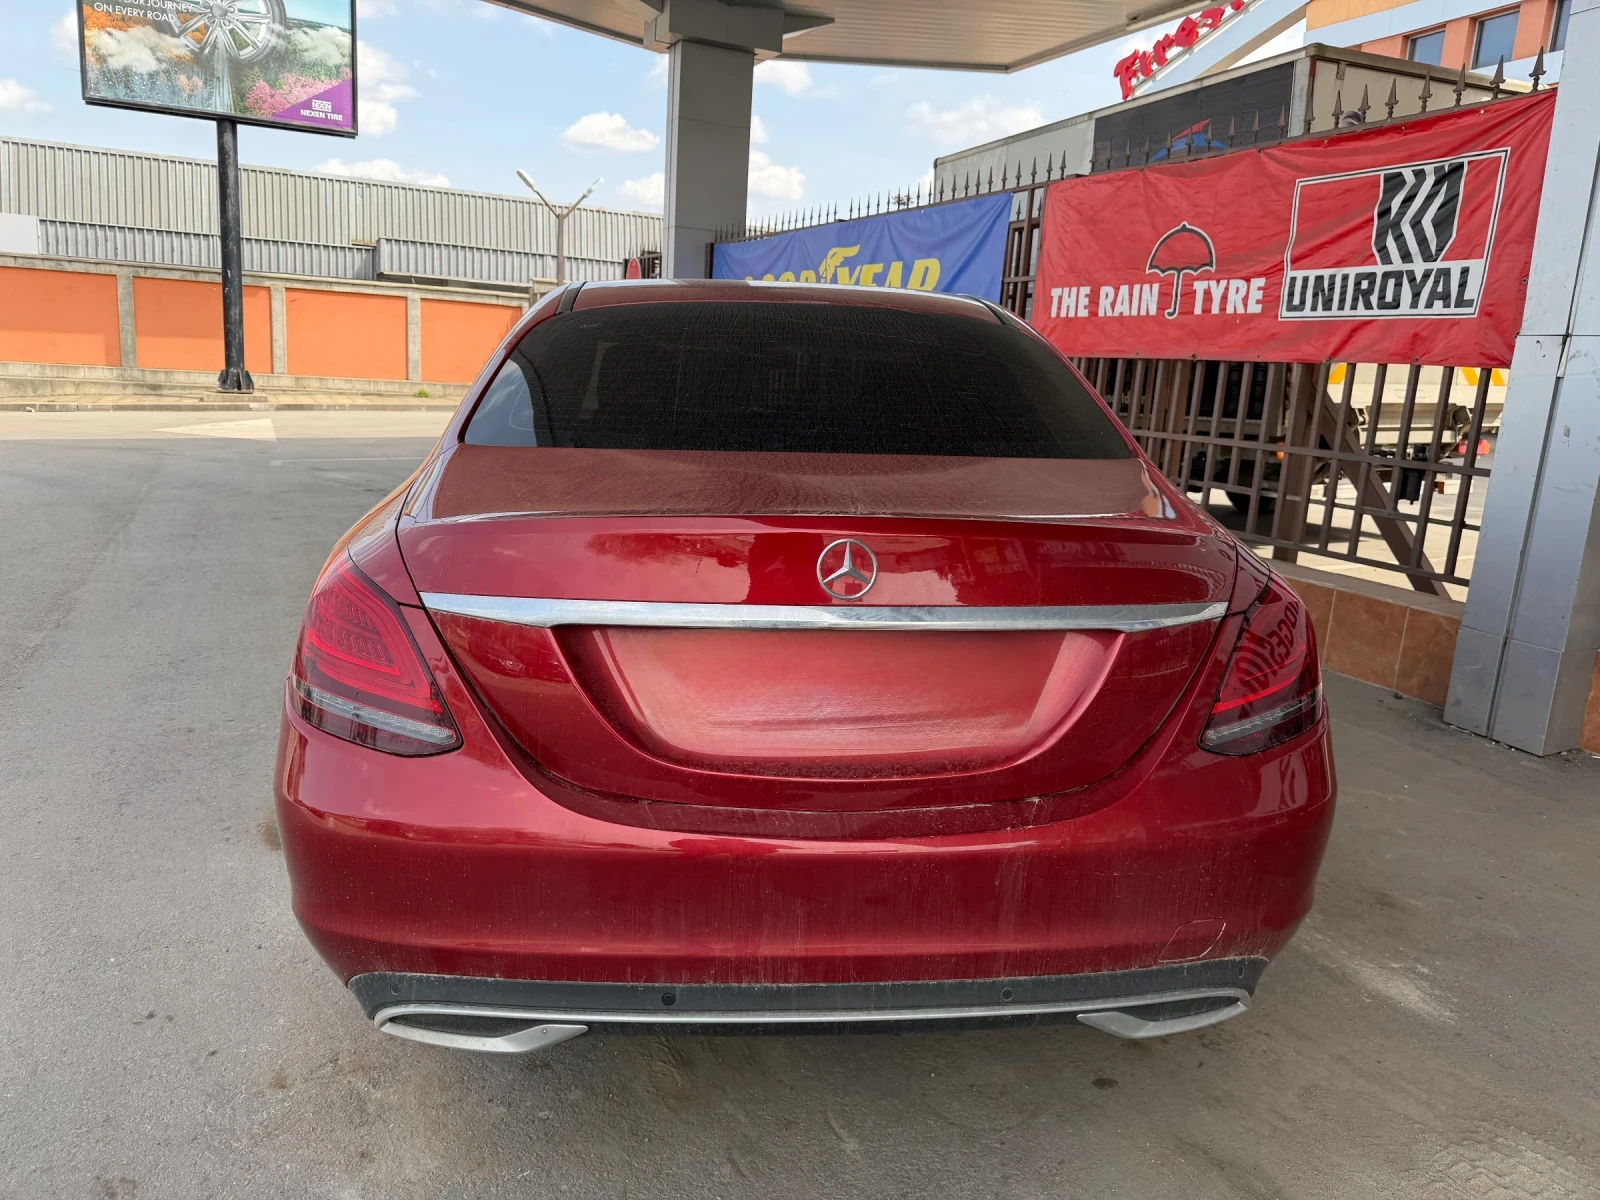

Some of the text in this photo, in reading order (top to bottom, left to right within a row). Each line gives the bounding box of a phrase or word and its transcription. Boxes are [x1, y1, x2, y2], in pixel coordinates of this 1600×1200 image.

[94, 2, 176, 22] ON EVERY ROAD
[147, 0, 192, 12] JOURNEY
[300, 109, 344, 121] NEXEN TIRE
[1050, 277, 1266, 318] THE RAIN TYRE
[1285, 265, 1476, 312] UNIROYAL
